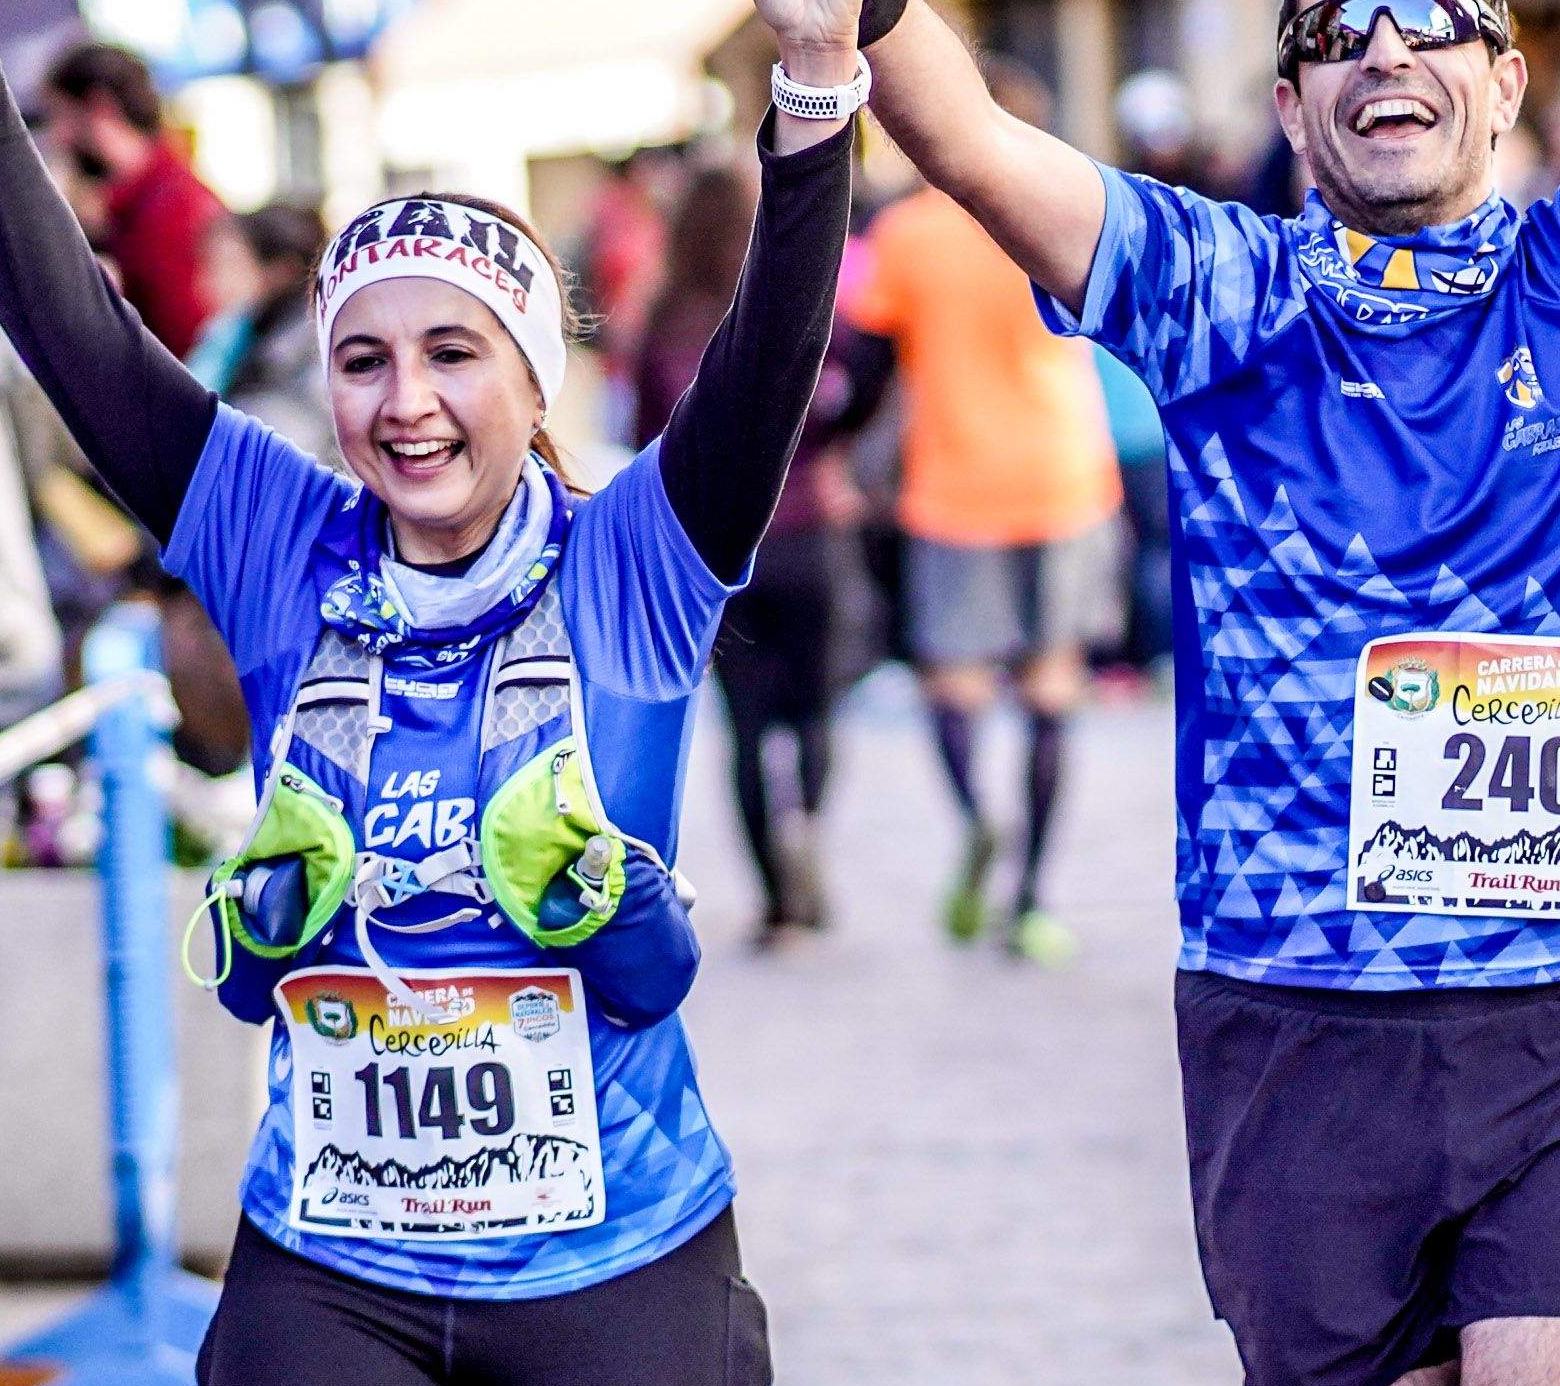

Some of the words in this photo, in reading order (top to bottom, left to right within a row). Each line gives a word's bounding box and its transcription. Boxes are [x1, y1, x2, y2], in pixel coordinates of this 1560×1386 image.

[1477, 655, 1554, 676] CARRERA
[380, 769, 441, 800] LAS
[1396, 869, 1433, 882] asics
[1468, 872, 1519, 890] Trail
[1521, 875, 1560, 892] Run
[355, 1061, 516, 1140] 1149
[340, 1192, 370, 1207] asics
[402, 1196, 447, 1214] Trail
[448, 1198, 491, 1212] Run
